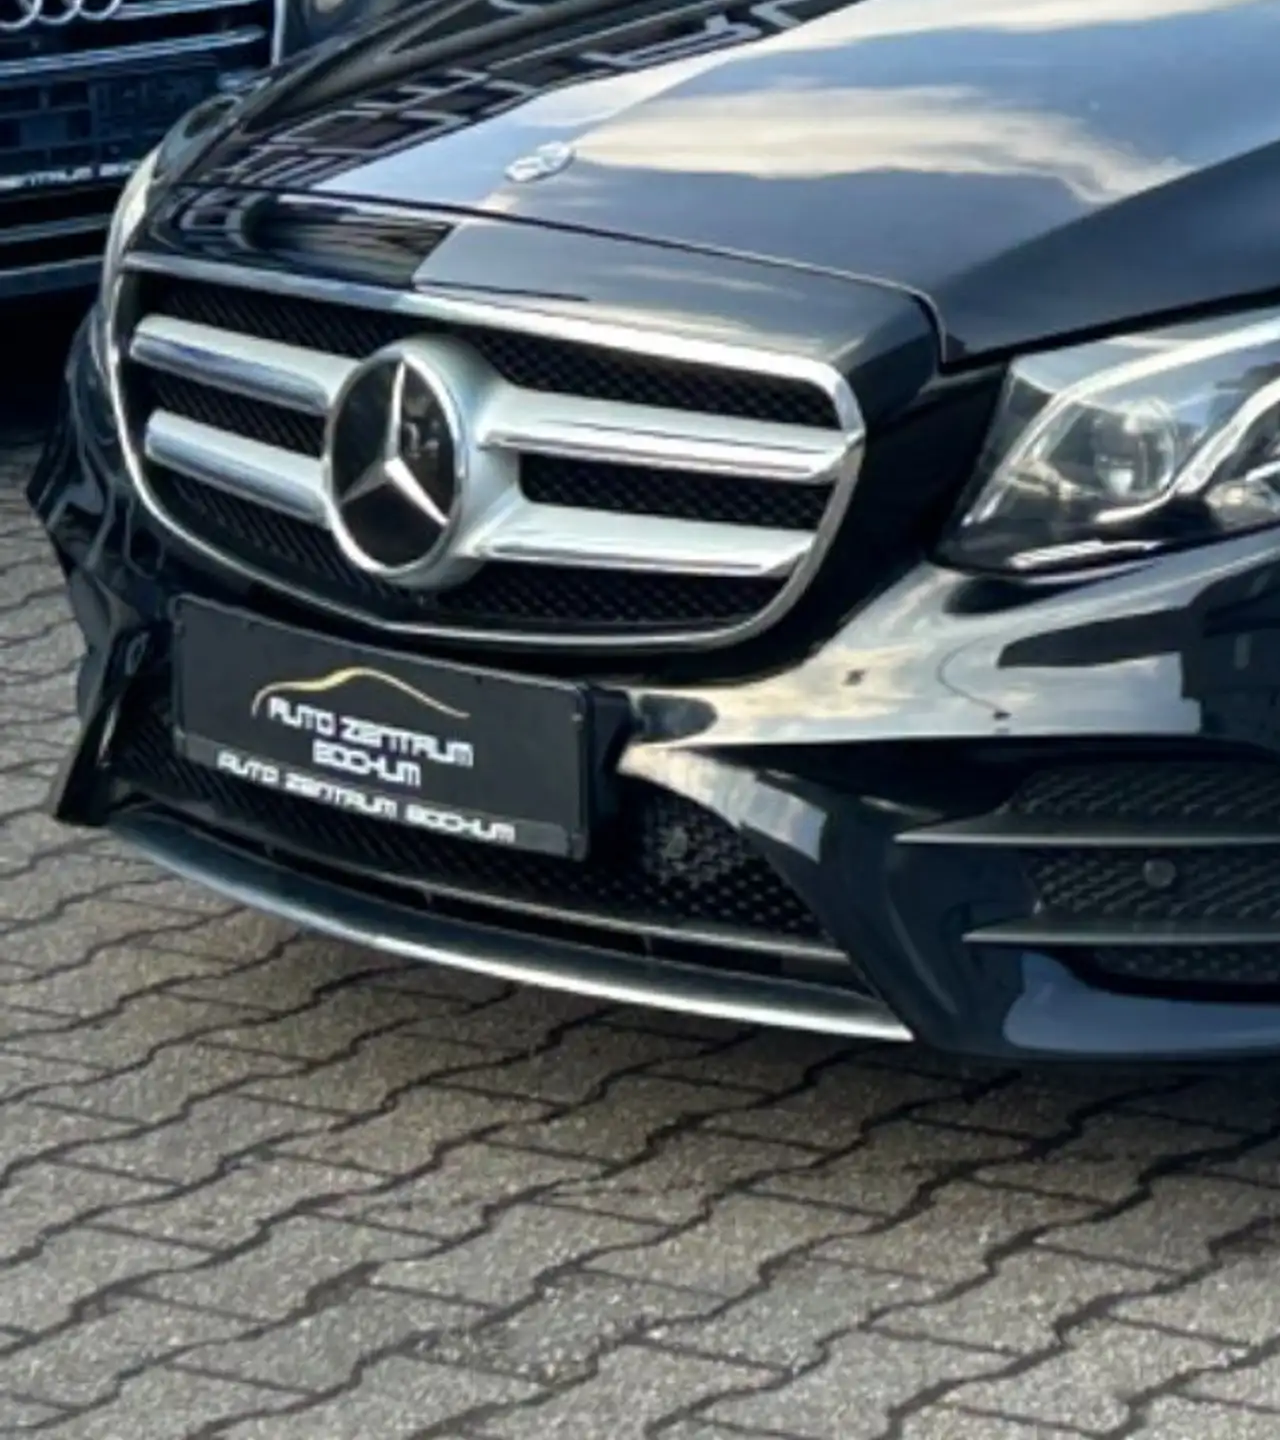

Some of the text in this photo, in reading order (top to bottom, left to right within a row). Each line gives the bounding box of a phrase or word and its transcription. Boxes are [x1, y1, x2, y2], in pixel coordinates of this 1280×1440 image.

[267, 695, 474, 769] AUTO ZENTRUM
[312, 738, 422, 788] BOCHUM
[216, 749, 516, 844] AUTO ZENTRUM BOCHUM
